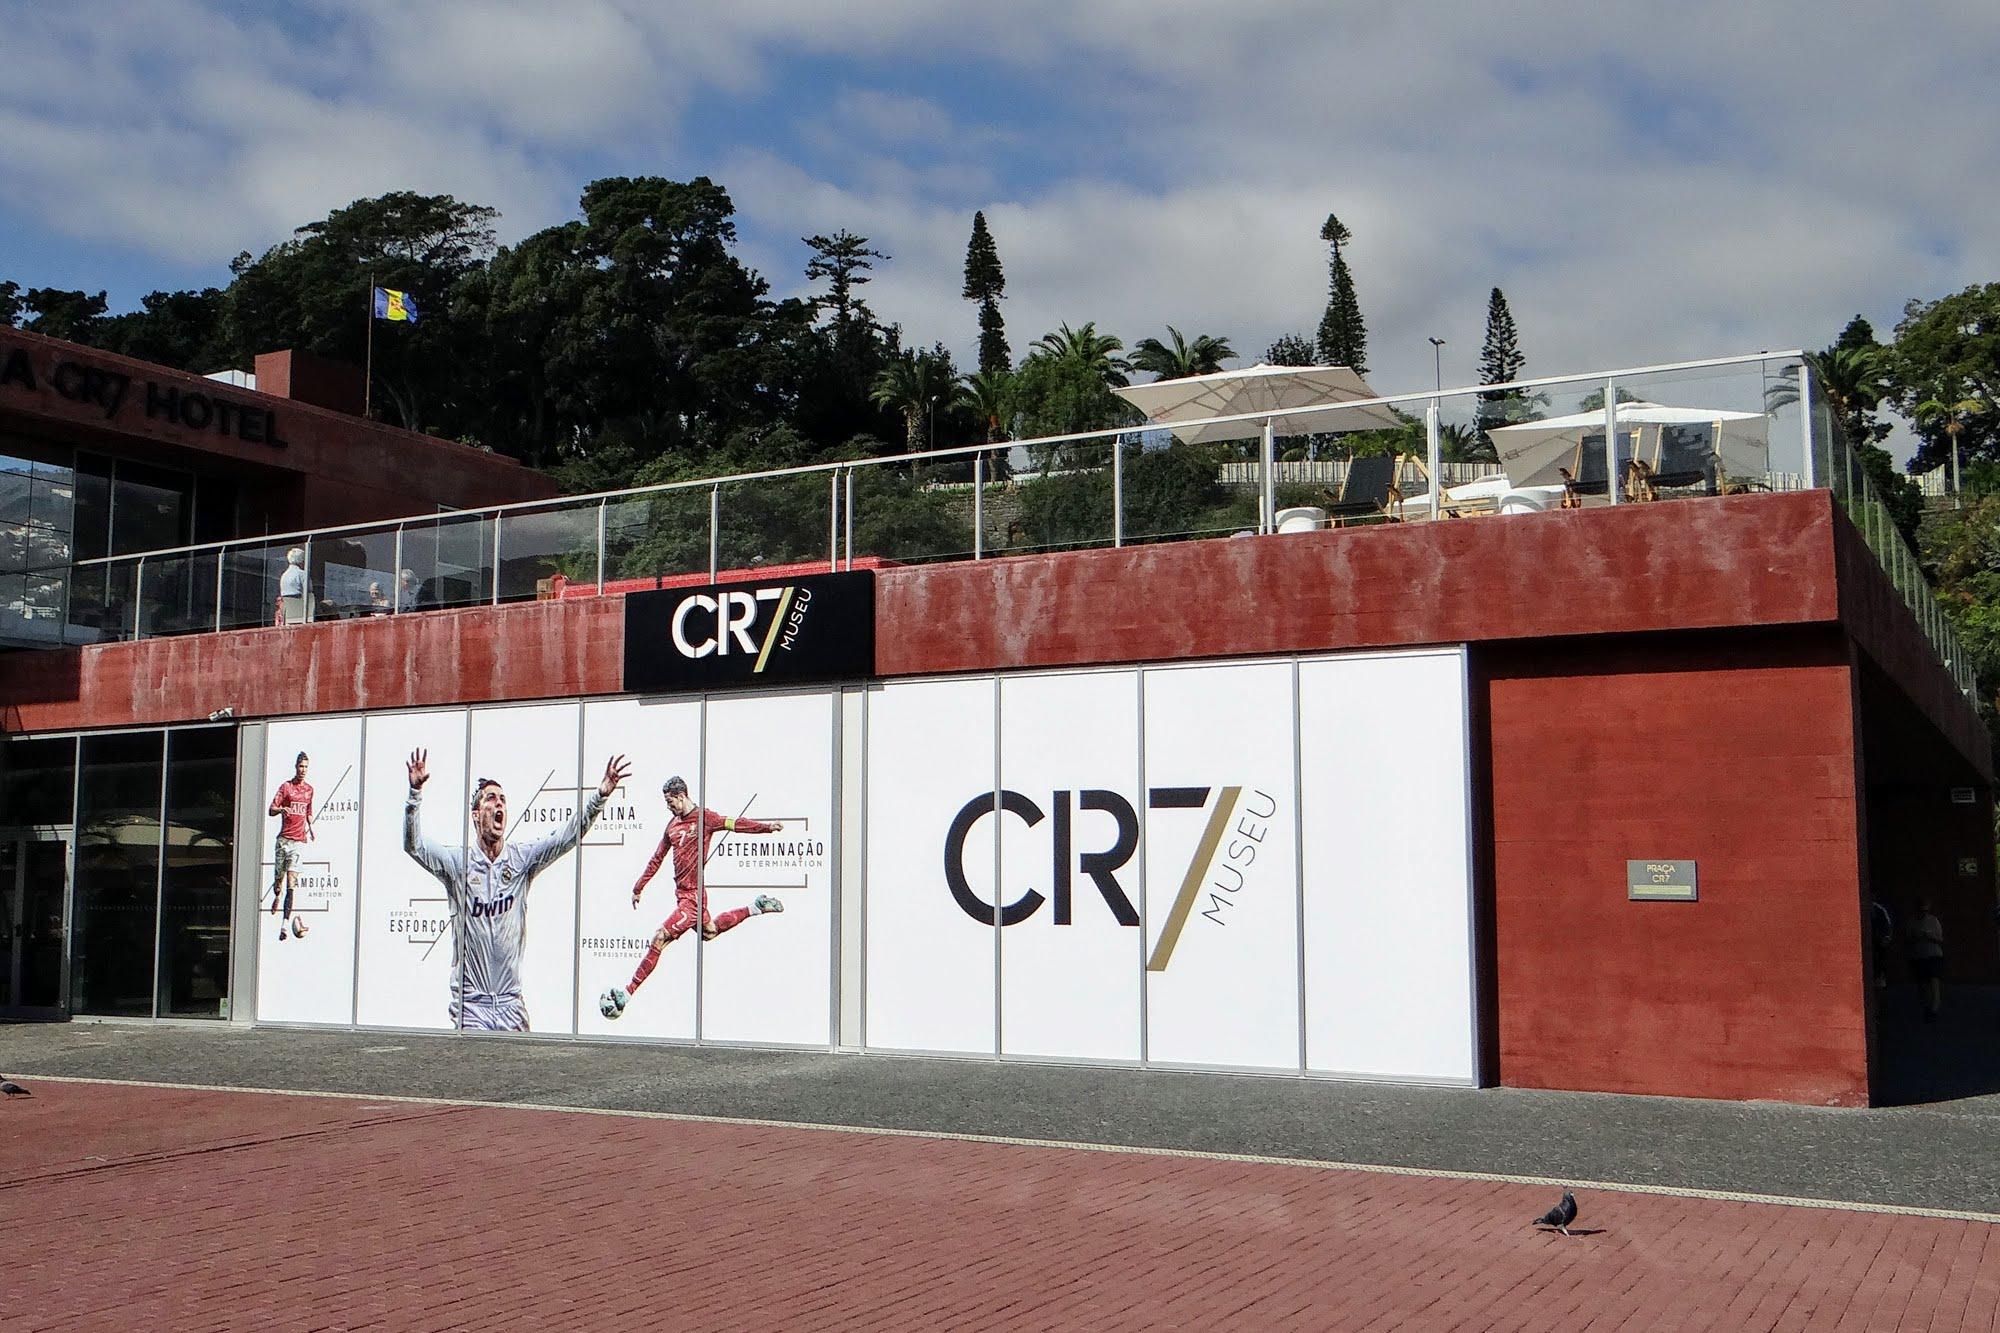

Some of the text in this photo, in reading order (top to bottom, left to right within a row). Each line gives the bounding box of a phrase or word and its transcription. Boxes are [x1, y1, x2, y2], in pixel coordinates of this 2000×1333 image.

[55, 361, 130, 420] CR7
[146, 381, 288, 449] HOTEL
[671, 586, 795, 673] CR7
[780, 588, 813, 651] MUSEU
[323, 799, 359, 812] PAIXÃO
[718, 839, 824, 860] DETERMINAÇÃO
[1201, 788, 1277, 927] MUSEU
[738, 860, 823, 868] DETERMINATION
[1646, 864, 1676, 874] PRAÇA
[944, 786, 1243, 972] CR7
[1652, 874, 1671, 883] CR7
[471, 893, 515, 918] bwin
[389, 920, 446, 936] ESFORÇO
[581, 936, 651, 950] PERSISTÊNCIA
